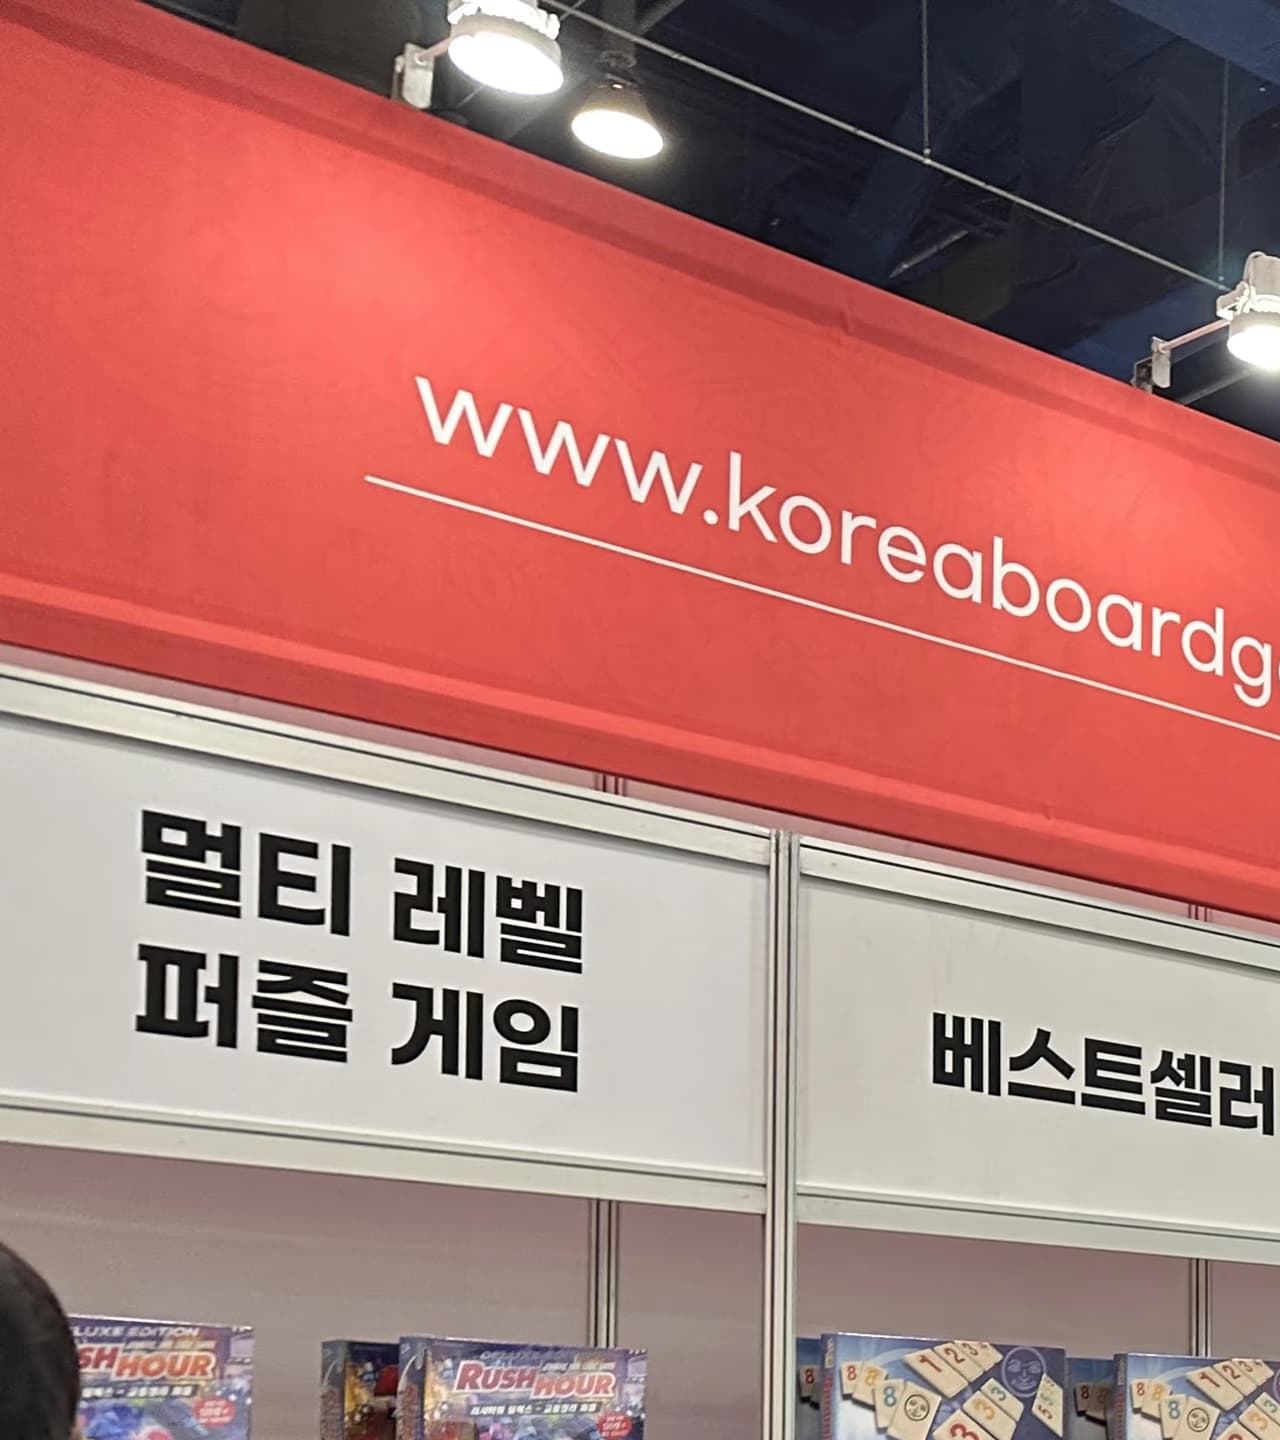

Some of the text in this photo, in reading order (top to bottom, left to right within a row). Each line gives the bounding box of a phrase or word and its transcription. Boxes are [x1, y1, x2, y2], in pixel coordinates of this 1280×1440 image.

[141, 808, 583, 975] 멀티 레벨
[136, 942, 579, 1093] 퍼즐 게임
[931, 1011, 1276, 1137] 베스트셀러
[70, 1326, 200, 1338] LUXE EDITION
[115, 1352, 216, 1380] HOUR
[455, 1359, 617, 1399] RUSH HOUR
